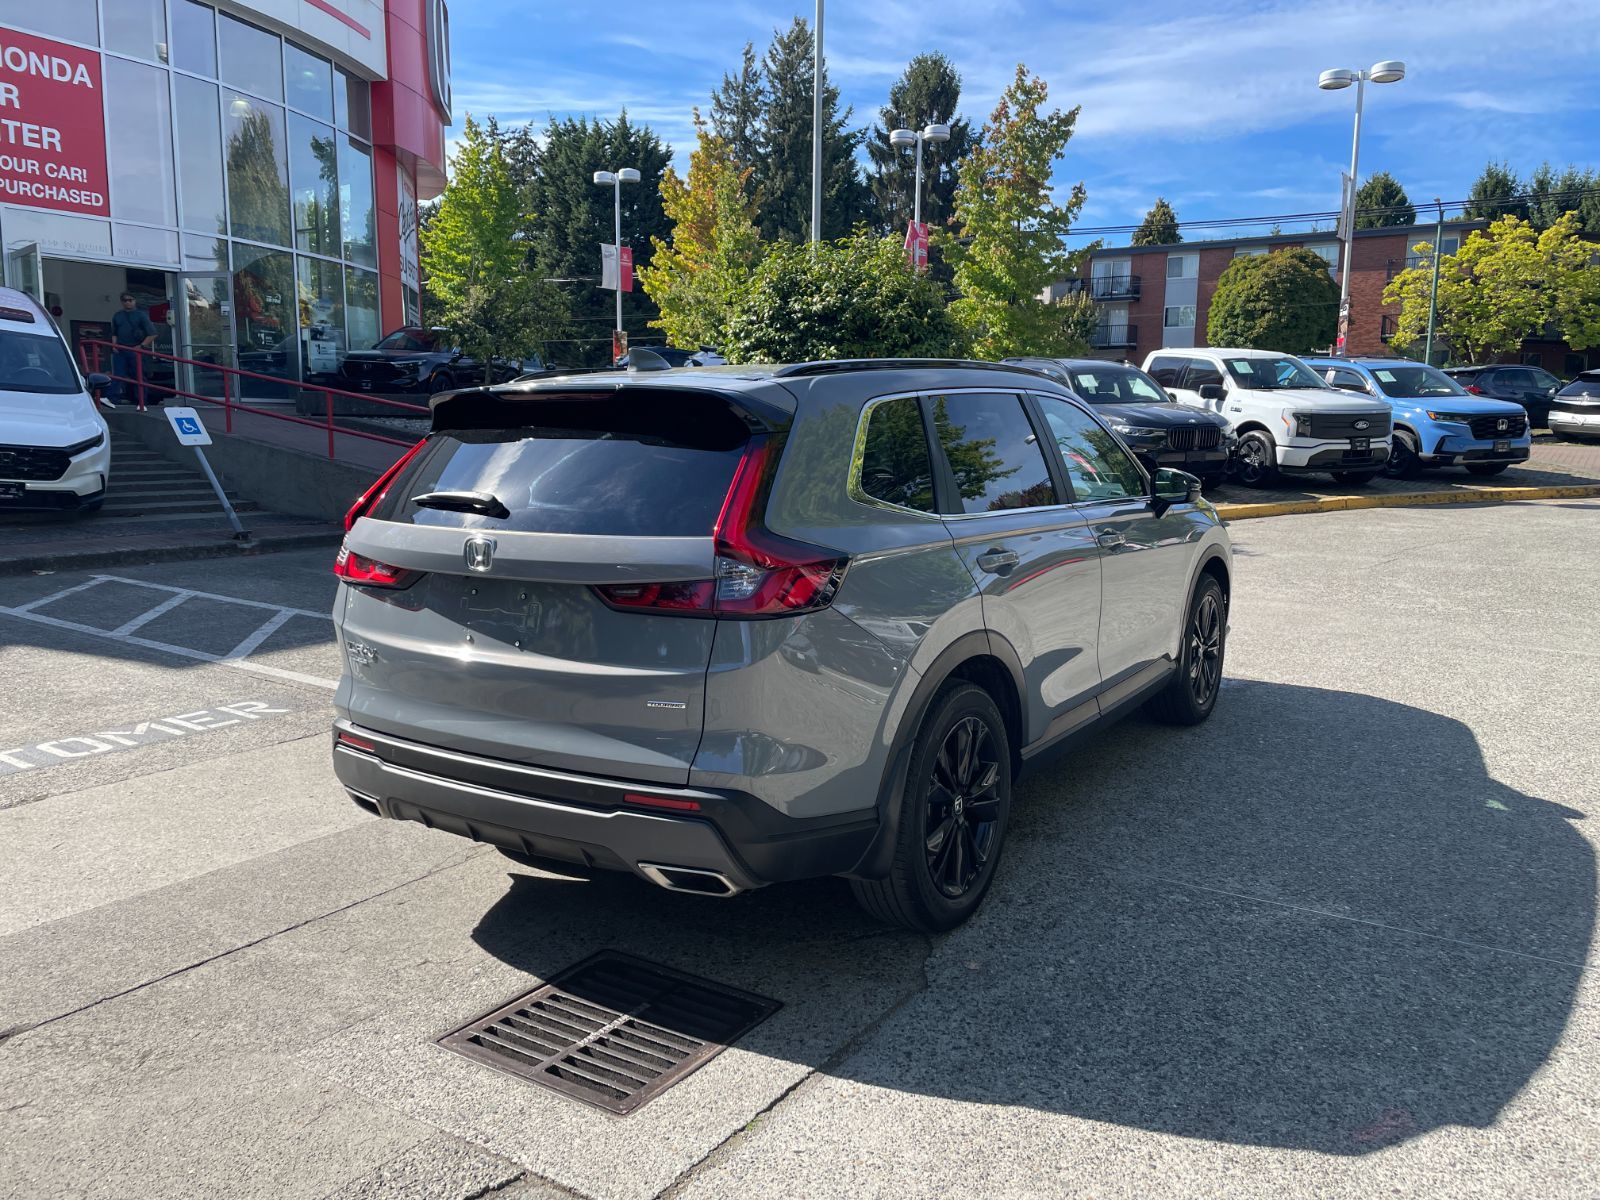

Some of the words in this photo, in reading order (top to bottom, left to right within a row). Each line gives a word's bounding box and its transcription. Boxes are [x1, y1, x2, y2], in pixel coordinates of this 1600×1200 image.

[0, 44, 93, 88] ONDA
[0, 118, 62, 152] TER
[45, 162, 87, 183] CAR!
